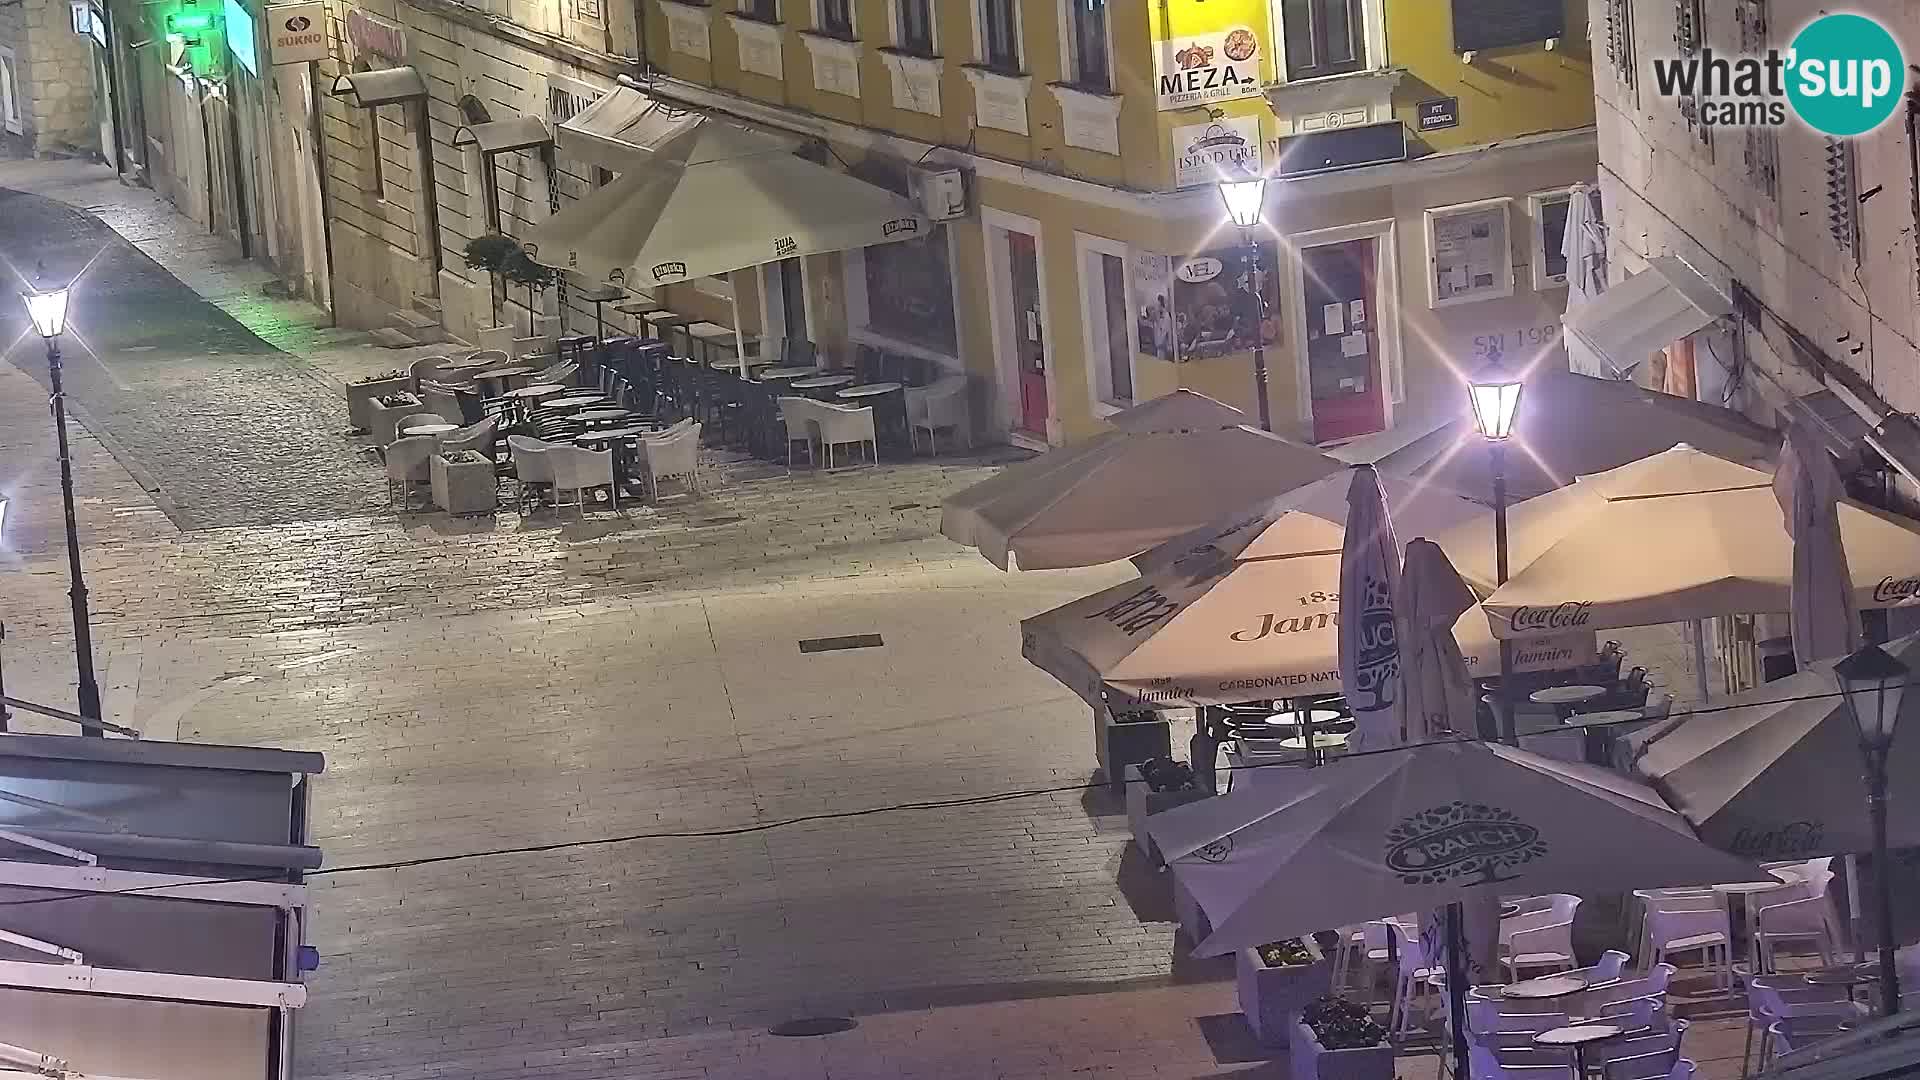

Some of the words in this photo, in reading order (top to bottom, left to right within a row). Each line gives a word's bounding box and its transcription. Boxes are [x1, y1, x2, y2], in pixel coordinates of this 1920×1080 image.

[277, 33, 322, 48] SUKNO
[1160, 65, 1239, 96] MEZA
[1169, 92, 1202, 103] PIZZERIA
[1210, 87, 1231, 97] GRILL
[1178, 151, 1225, 169] ISPOD
[1297, 591, 1340, 606] 182
[1230, 612, 1340, 642] Jam
[1219, 674, 1311, 691] CARBONATED
[1311, 670, 1341, 685] NATU
[1464, 656, 1479, 666] ER
